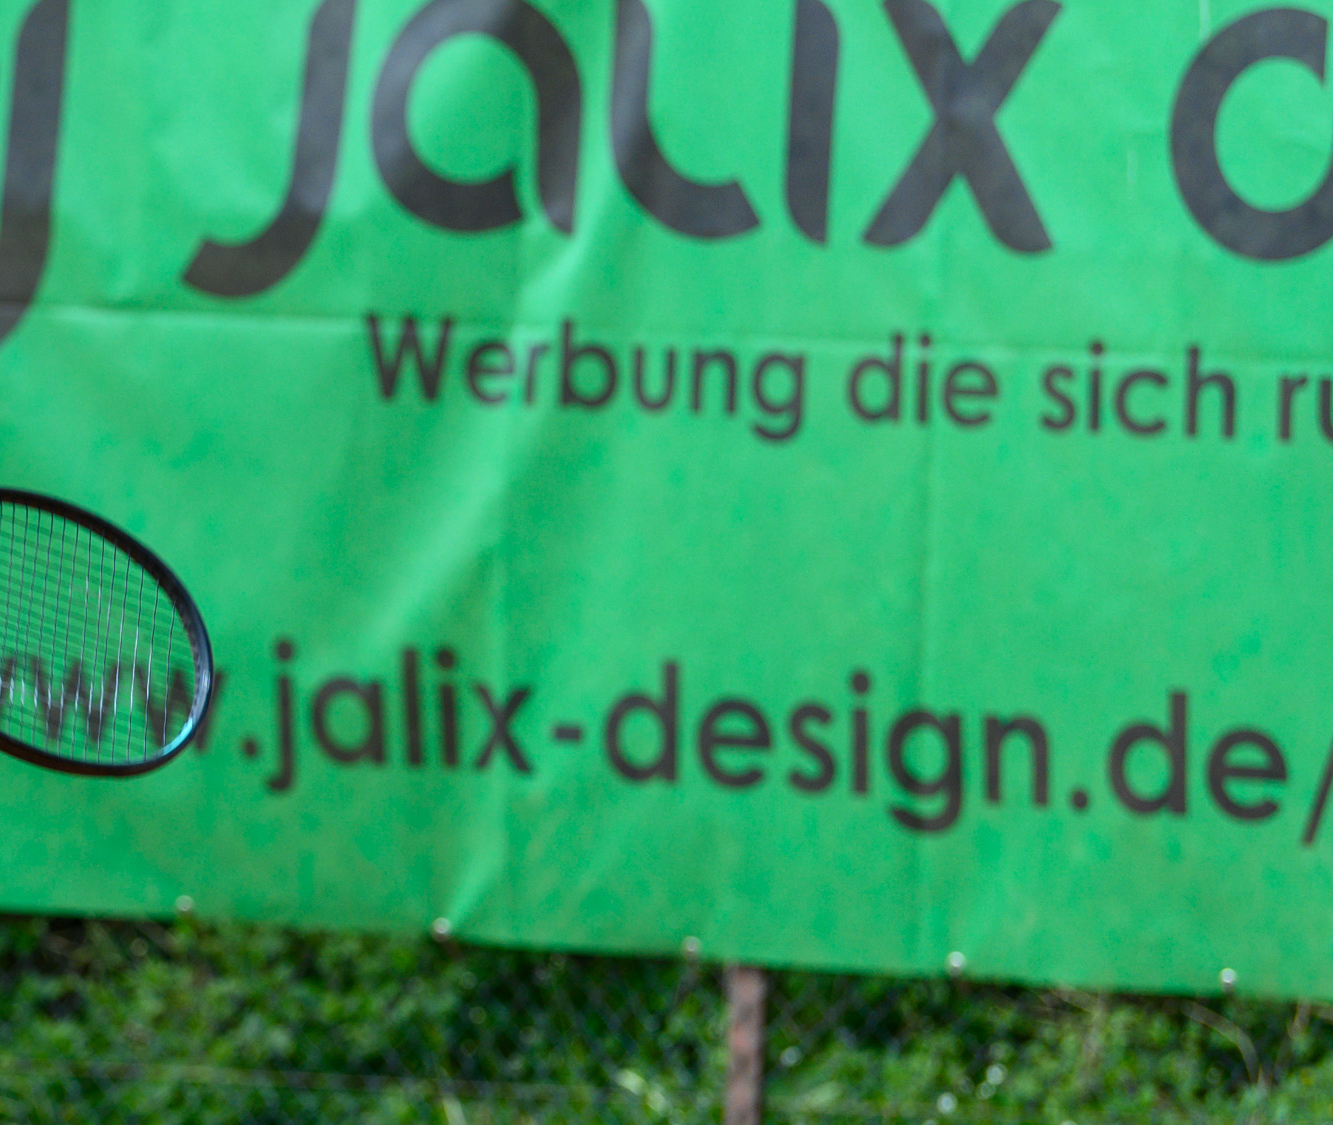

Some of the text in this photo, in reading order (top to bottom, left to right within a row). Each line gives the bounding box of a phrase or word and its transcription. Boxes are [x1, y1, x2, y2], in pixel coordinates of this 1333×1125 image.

[366, 313, 806, 442] Werbung
[849, 333, 999, 427] die
[1041, 340, 1238, 440] sich
